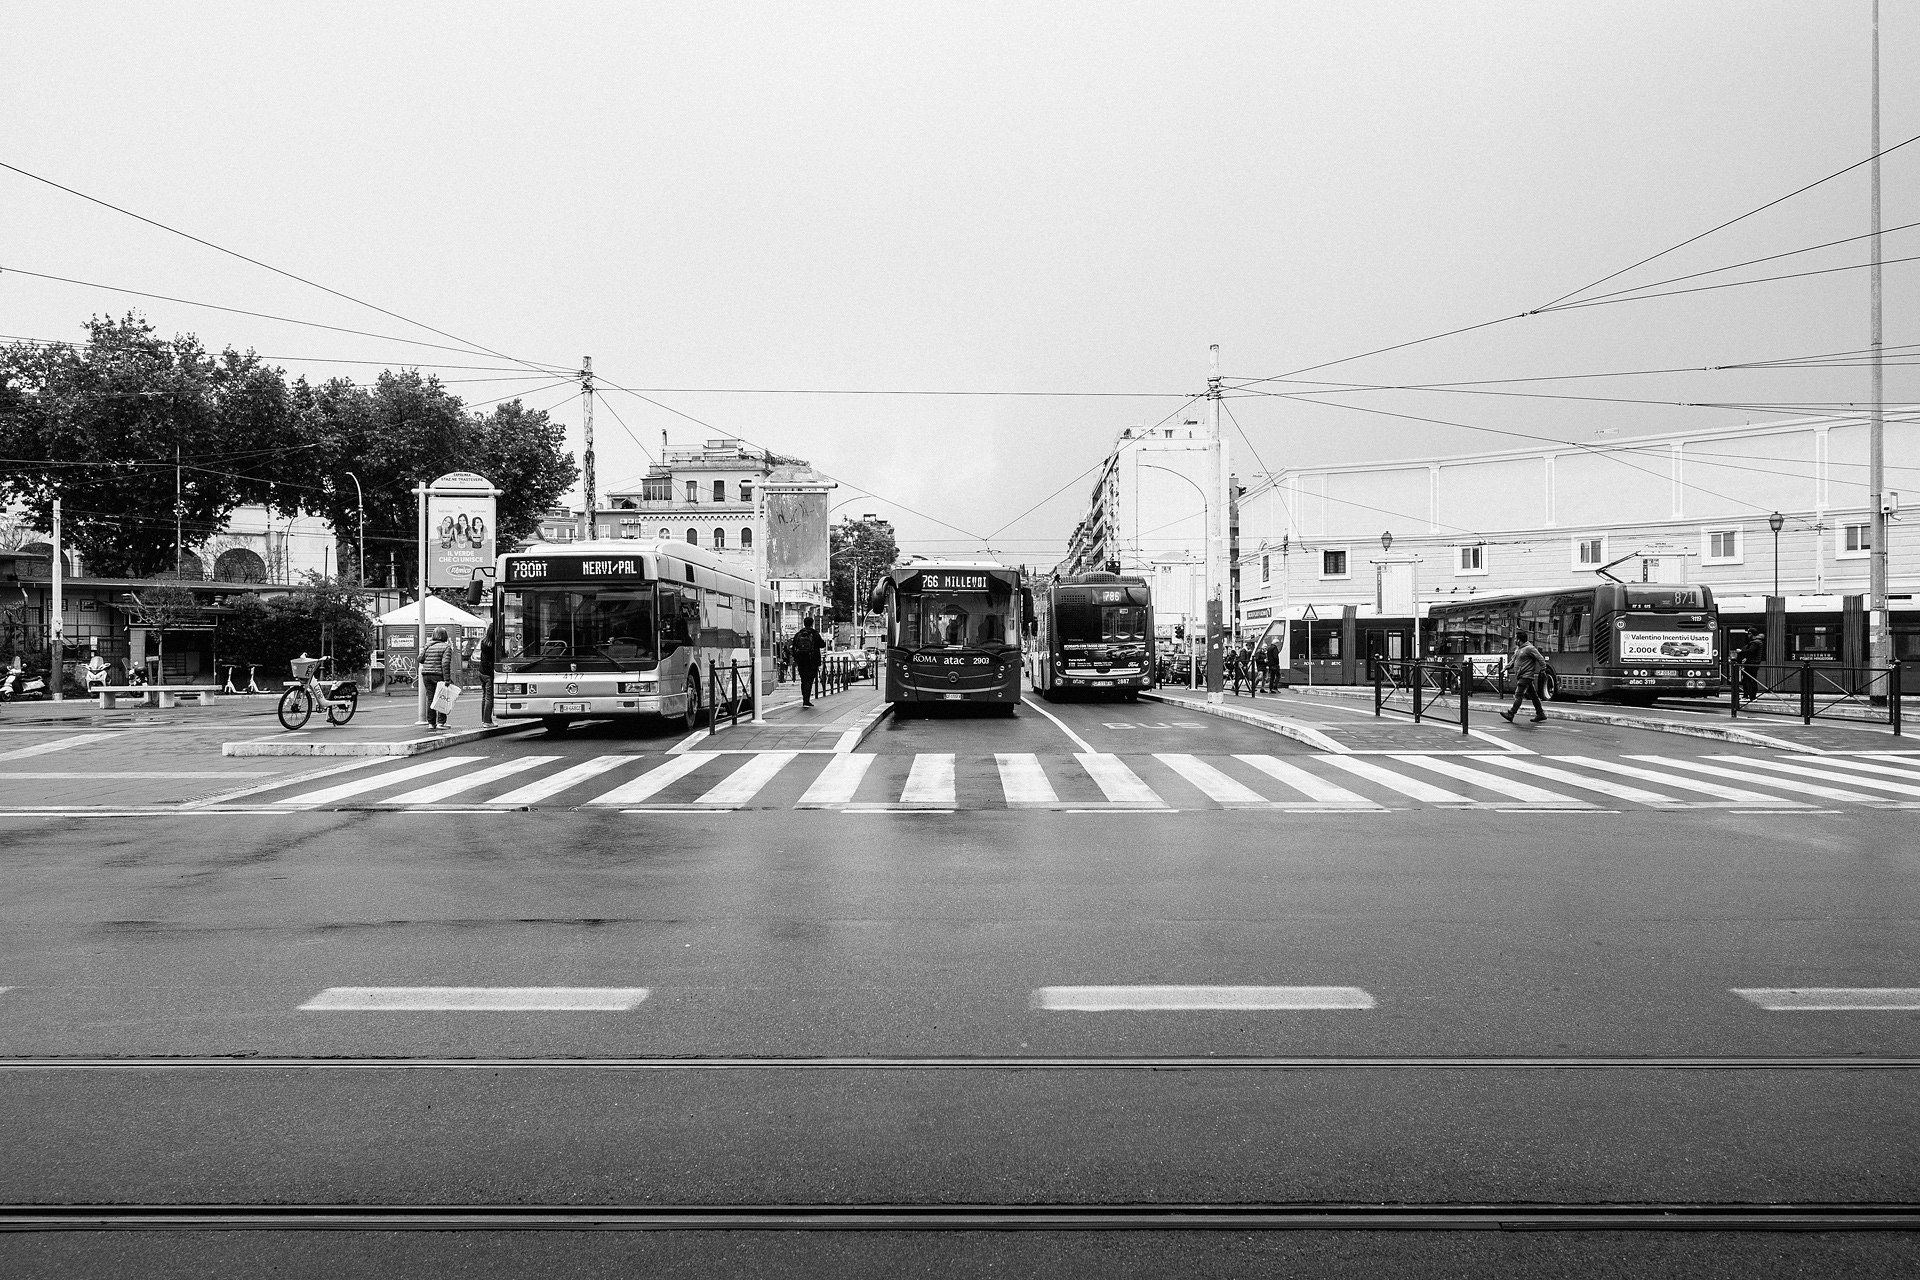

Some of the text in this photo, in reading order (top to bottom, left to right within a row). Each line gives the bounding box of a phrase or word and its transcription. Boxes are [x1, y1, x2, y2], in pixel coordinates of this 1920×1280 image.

[582, 561, 638, 575] NERVI/PAL
[922, 575, 987, 588] 766 MILLEVOI
[1104, 591, 1120, 601] 786
[1674, 591, 1695, 605] 871
[912, 655, 990, 665] ROMA atac 2903
[1101, 722, 1209, 730] BUS
